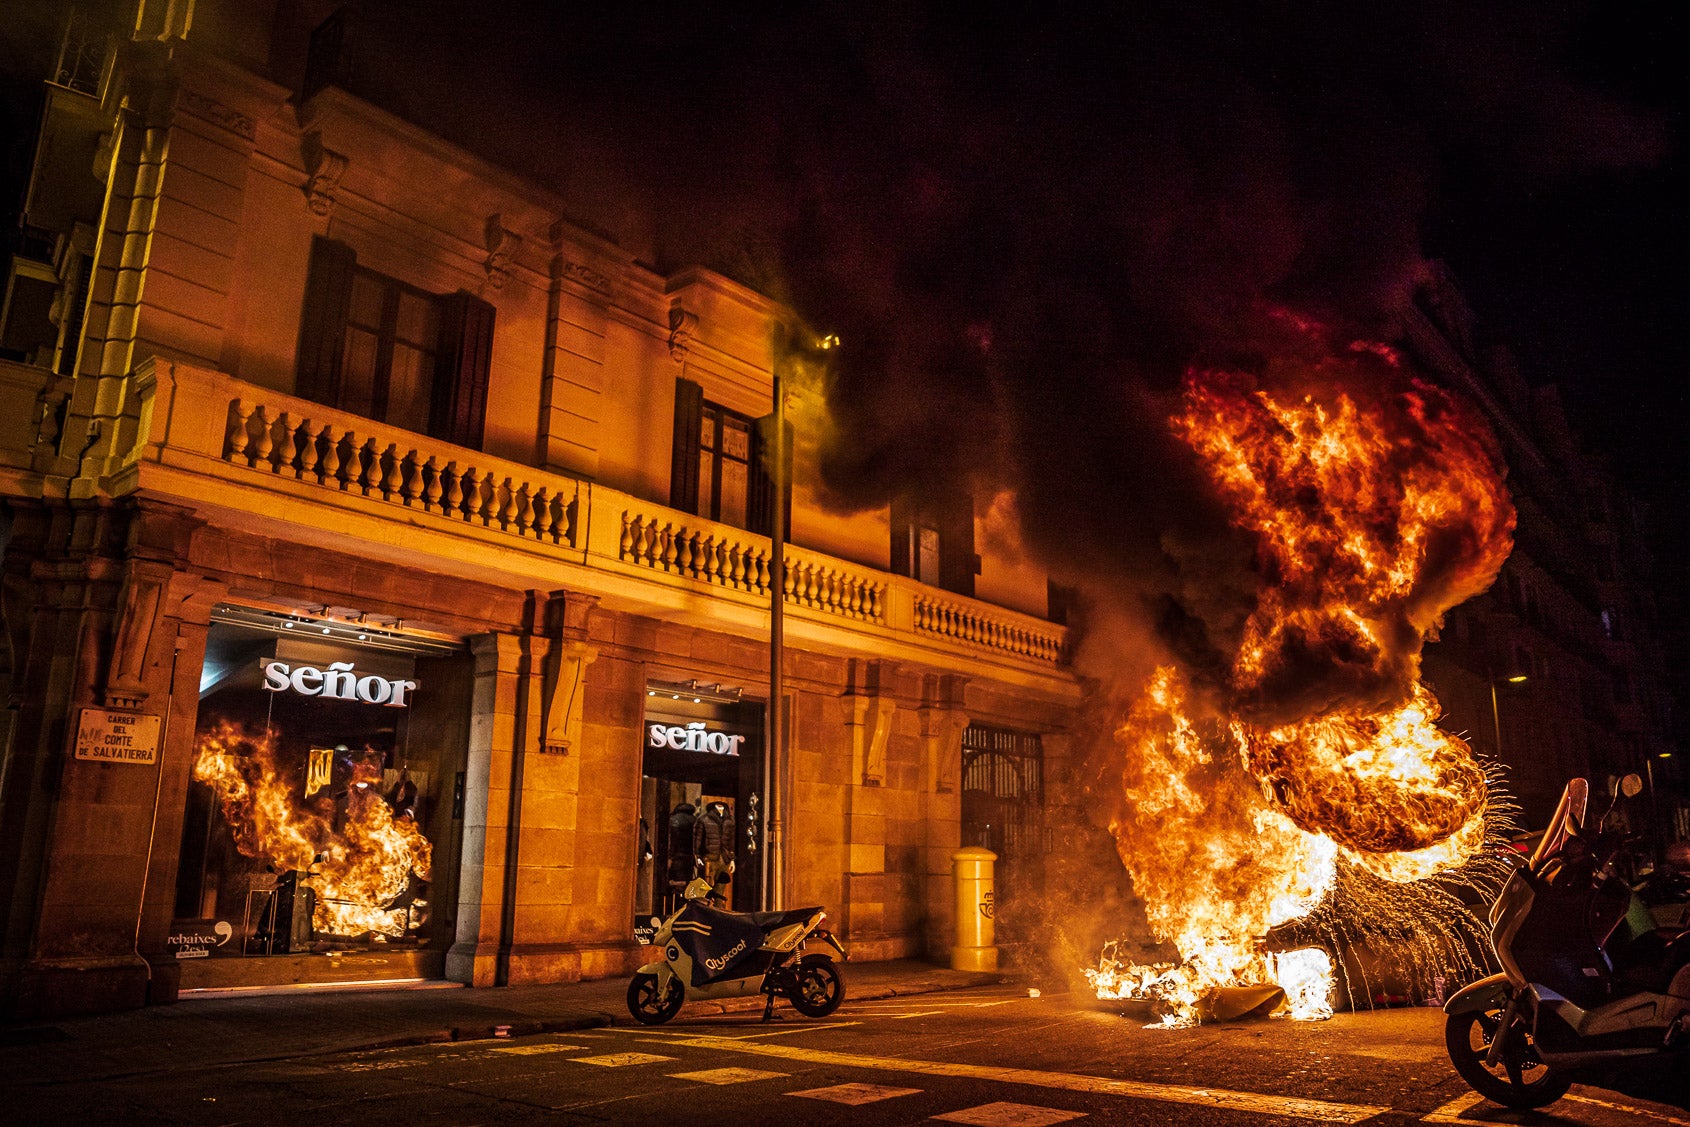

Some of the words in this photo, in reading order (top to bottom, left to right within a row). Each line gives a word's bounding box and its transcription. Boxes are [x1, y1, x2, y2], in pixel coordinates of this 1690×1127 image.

[264, 662, 417, 707] señor
[107, 715, 136, 725] CARRER
[113, 725, 127, 735] DEL
[104, 735, 133, 747] COMTE
[648, 721, 745, 757] señor
[79, 748, 89, 756] DE
[93, 746, 153, 761] SALVATIERRA
[167, 932, 217, 945] rebaixes
